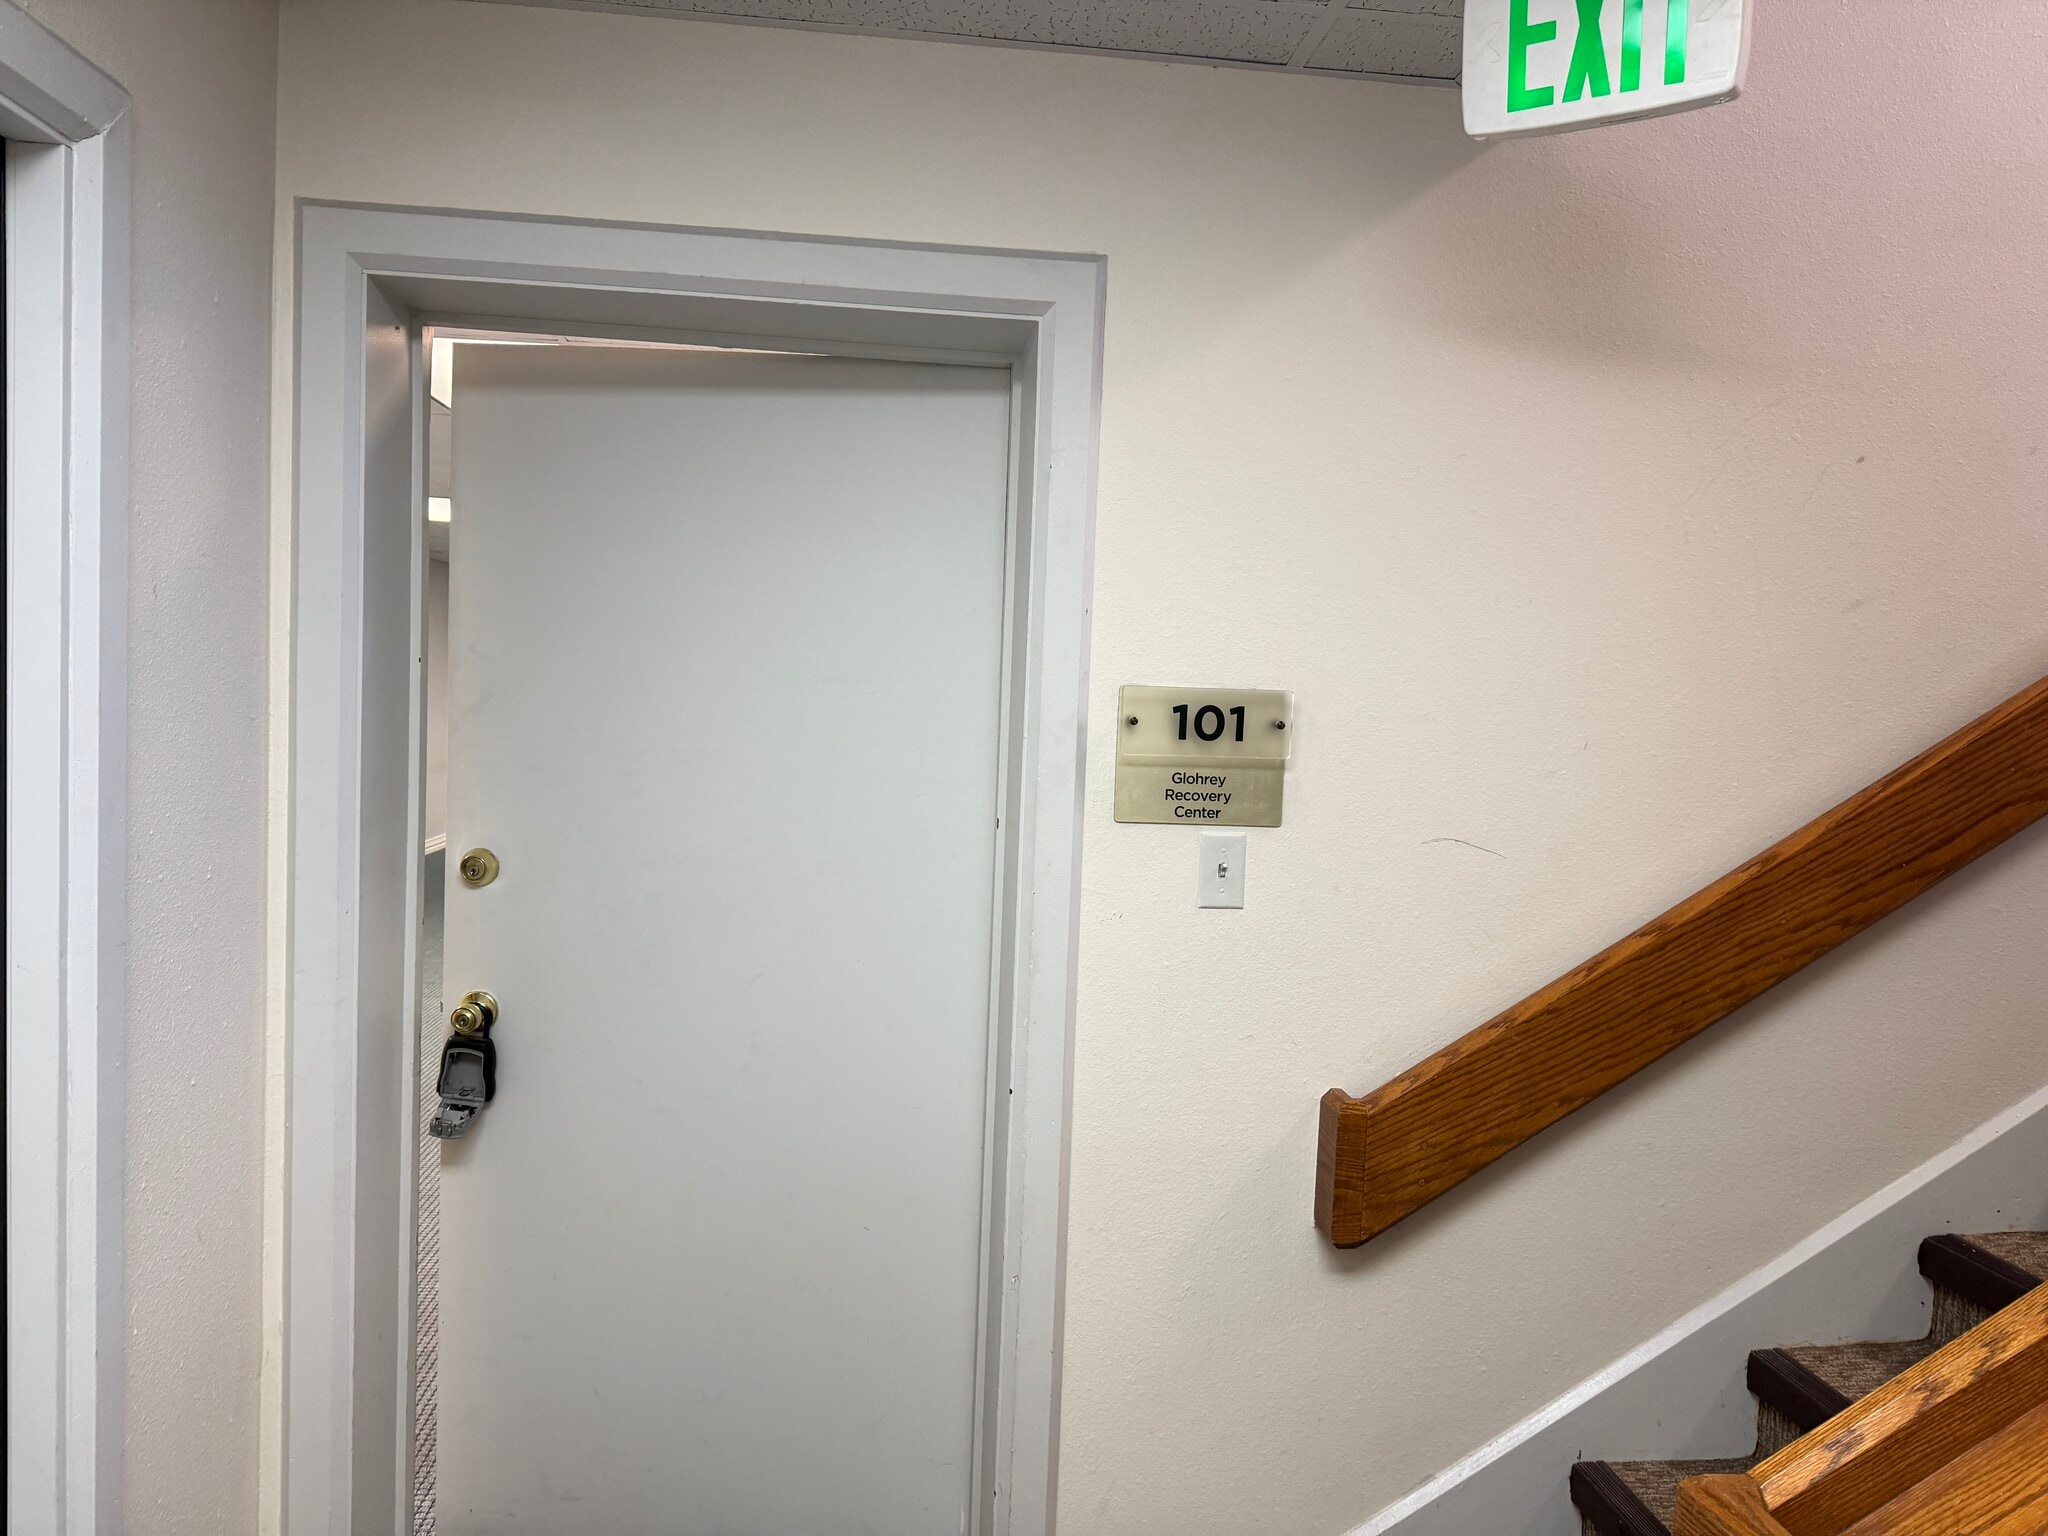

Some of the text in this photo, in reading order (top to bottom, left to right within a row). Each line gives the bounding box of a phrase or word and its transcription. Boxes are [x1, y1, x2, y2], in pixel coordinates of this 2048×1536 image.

[1172, 704, 1246, 742] 101
[1171, 772, 1227, 788] Glohrey
[1165, 788, 1232, 805] Recovery
[1174, 805, 1222, 819] Center
